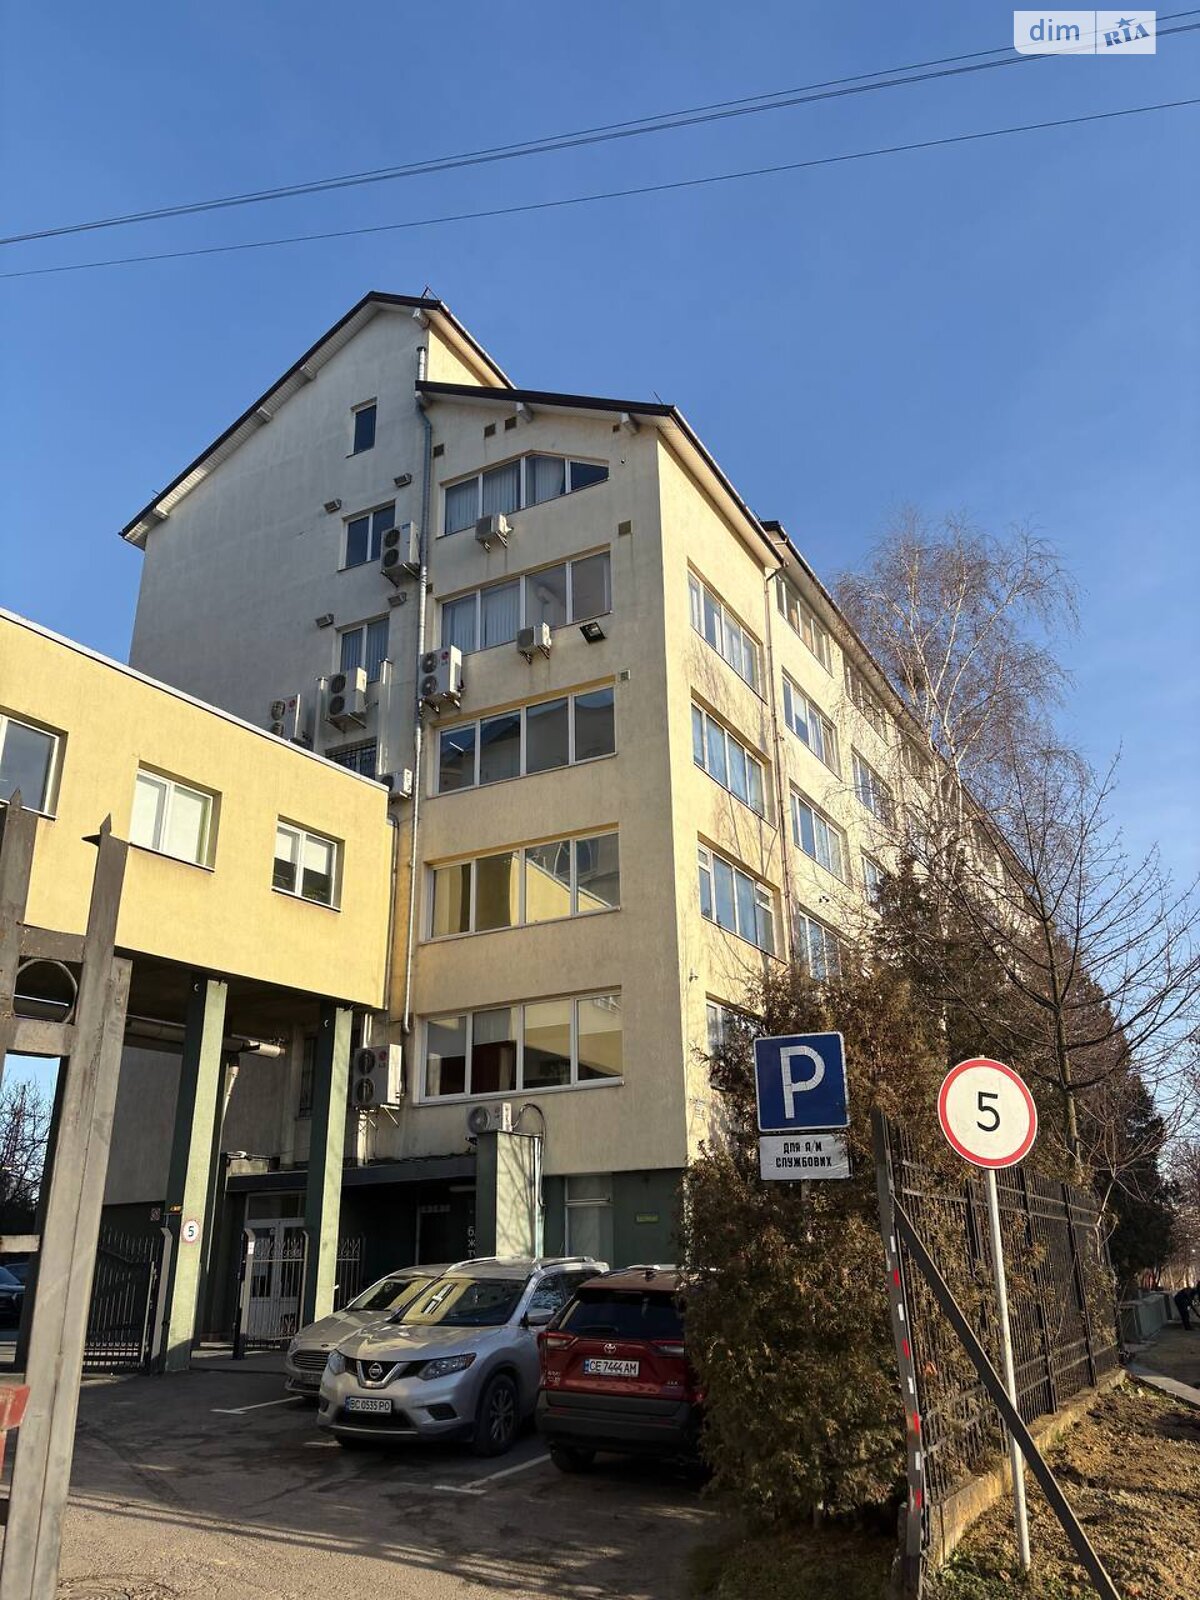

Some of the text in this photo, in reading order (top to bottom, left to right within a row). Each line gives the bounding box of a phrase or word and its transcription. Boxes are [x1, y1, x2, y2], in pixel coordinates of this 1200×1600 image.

[779, 1045, 826, 1119] P
[976, 1091, 1001, 1132] 5
[783, 1142, 801, 1154] ДЛЯ
[775, 1156, 832, 1168] СЛУЖБОВИХ
[188, 1225, 195, 1237] 5
[589, 1360, 637, 1374] CE 7444 AM
